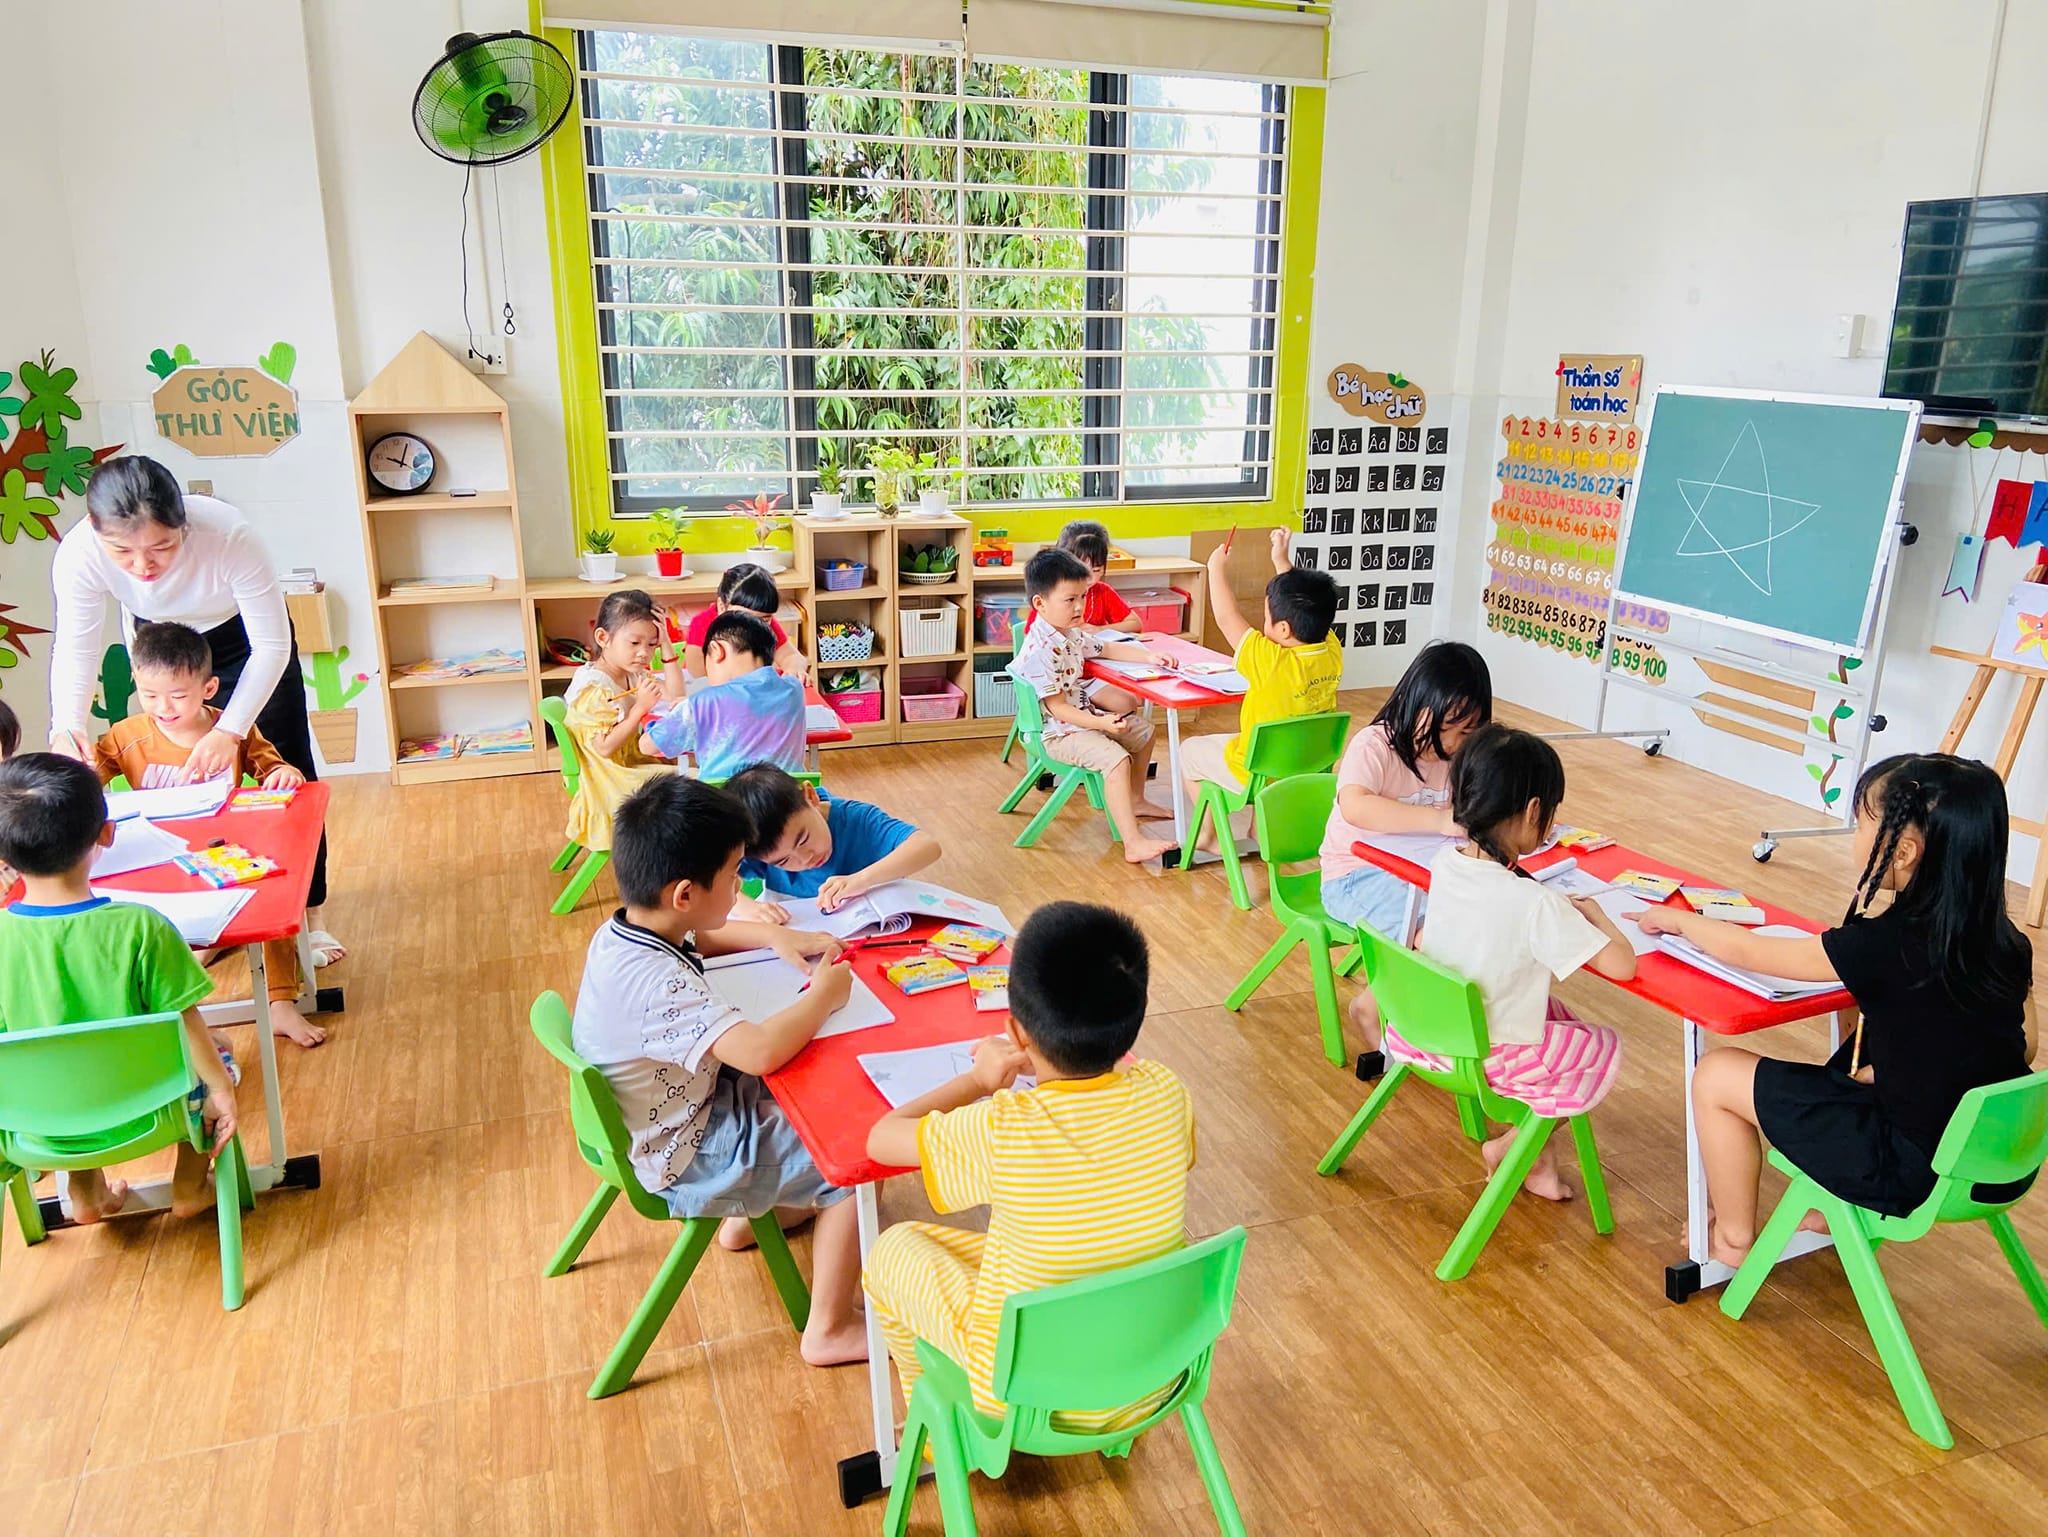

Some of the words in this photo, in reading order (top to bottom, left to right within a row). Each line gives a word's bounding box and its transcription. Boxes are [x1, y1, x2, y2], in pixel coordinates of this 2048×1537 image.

[186, 369, 250, 403] GÓC
[1335, 372, 1360, 397] Bé
[1563, 364, 1601, 387] Thần
[1360, 382, 1394, 406] học
[1385, 394, 1424, 419] chữ
[1570, 391, 1601, 411] toán
[1603, 392, 1629, 416] học
[155, 408, 222, 437] THƯ
[1505, 419, 1512, 435] 1
[1521, 419, 1530, 436] 2
[1537, 421, 1546, 438] 3
[1553, 423, 1562, 439] 4
[1571, 426, 1580, 443] 5
[1588, 426, 1597, 444] 6
[1608, 429, 1616, 446] 7
[1627, 430, 1636, 449] 8
[1397, 431, 1417, 451] Bb
[1426, 435, 1443, 452] Cc
[1368, 473, 1385, 490] Ee
[1394, 468, 1411, 490] Êê
[1423, 470, 1440, 490] Gg
[1497, 462, 1511, 478] 21
[1513, 464, 1527, 480] 22
[1529, 468, 1543, 483] 23
[1545, 470, 1560, 485] 24
[1561, 472, 1577, 488] 25
[1579, 475, 1595, 492] 26
[1598, 477, 1614, 496] 27
[1518, 488, 1532, 504] 32
[1568, 496, 1583, 515] 35
[1585, 500, 1601, 517] 36
[1603, 502, 1620, 520] 37
[1305, 511, 1323, 531] Hh
[1362, 513, 1381, 531] Kk
[1388, 513, 1405, 531] Ll
[1414, 513, 1436, 531] Mm
[1492, 503, 1505, 518] 41
[1507, 506, 1521, 522] 42
[1523, 509, 1537, 524] 43
[1539, 513, 1553, 528] 44
[1556, 517, 1570, 532] 45
[1572, 522, 1588, 536] 46
[1591, 526, 1608, 542] 47
[1330, 551, 1348, 567] Oo
[1361, 547, 1379, 568] Ôô
[1414, 547, 1431, 569] Pp
[1487, 546, 1500, 562] 61
[1501, 550, 1516, 567] 62
[1517, 554, 1531, 570] 63
[1533, 559, 1547, 573] 64
[1550, 562, 1565, 577] 65
[1567, 566, 1582, 582] 66
[1585, 571, 1600, 587] 67
[1357, 588, 1376, 608] Ss
[1385, 591, 1403, 608] Tt
[1411, 585, 1429, 603] Uu
[1483, 588, 1496, 605] 81
[1498, 594, 1511, 611] 82
[1512, 597, 1527, 614] 83
[1527, 600, 1542, 616] 84
[1543, 604, 1559, 622] 85
[1561, 610, 1577, 627] 86
[1579, 614, 1596, 632] 87
[1354, 627, 1371, 643] Xx
[1385, 625, 1403, 643] Yy
[1487, 612, 1500, 628] 91
[1502, 616, 1516, 633] 92
[1518, 619, 1533, 639] 93
[1534, 625, 1548, 642] 94
[1550, 629, 1565, 648] 95
[1567, 635, 1582, 652] 96
[1623, 650, 1640, 671] 99
[1643, 655, 1667, 678] 100
